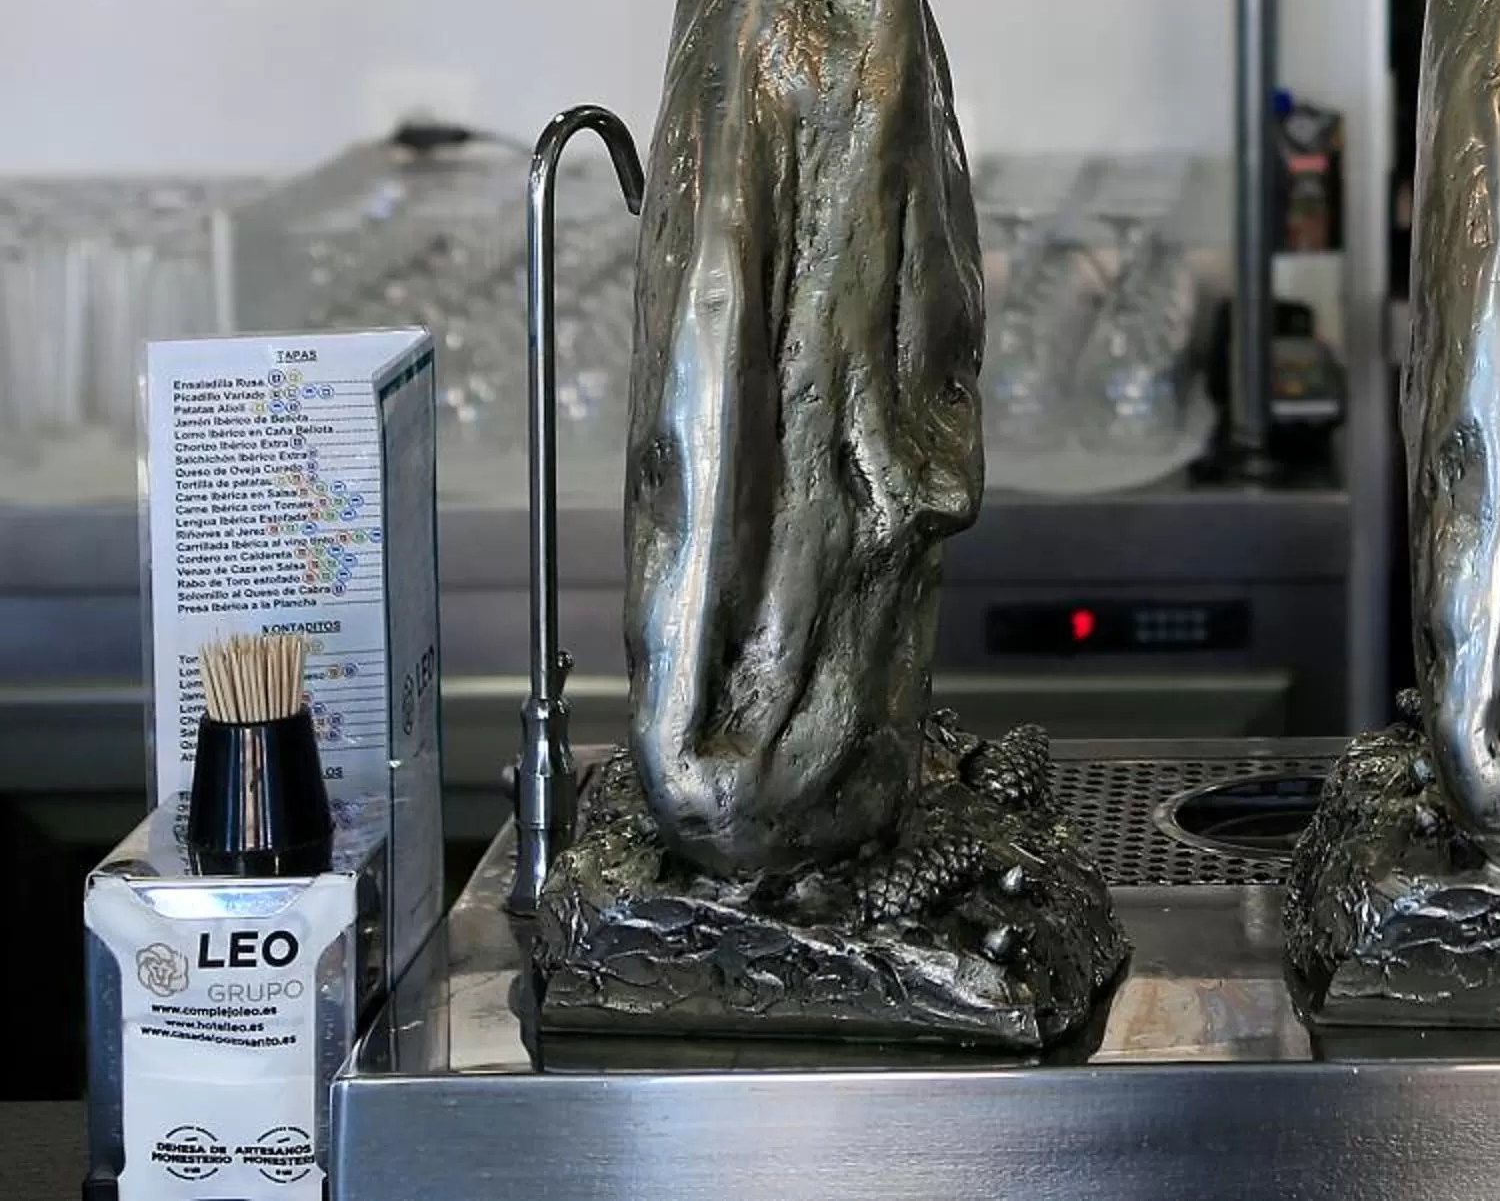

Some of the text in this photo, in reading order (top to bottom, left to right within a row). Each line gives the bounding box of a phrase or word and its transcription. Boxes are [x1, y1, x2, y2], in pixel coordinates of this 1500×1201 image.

[276, 350, 317, 362] TAPAS
[174, 379, 232, 389] Ensaladilla
[174, 391, 264, 401] Picadillo Variado
[174, 405, 214, 414] Patatas
[214, 415, 250, 426] Ibérico
[254, 415, 267, 423] de
[272, 414, 308, 423] Bellota
[175, 425, 333, 440] Lomo Ibérico en Caña Bellota
[175, 439, 288, 452] Chorizo Ibérico Extra
[240, 453, 276, 461] Ibérico
[280, 451, 306, 460] Extra
[176, 464, 302, 478] Queso de Oveja Curado
[176, 480, 212, 489] Tortilla
[216, 479, 229, 487] de
[176, 493, 208, 501] Carne
[211, 491, 248, 500] Ibérica
[267, 489, 296, 497] Salsa
[176, 501, 314, 515] Carne Ibérica con Tomate
[176, 513, 307, 529] Lengua Ibérica Estofada
[224, 529, 234, 537] al
[236, 528, 264, 537] Jerez
[232, 540, 268, 549] Ibérica
[272, 539, 280, 547] al
[284, 538, 306, 547] vino
[177, 550, 292, 564] Cordero en Caldereta
[214, 565, 227, 575] de
[230, 564, 256, 573] Caza
[260, 564, 273, 572] en
[276, 562, 305, 571] Salsa
[177, 575, 300, 589] Rabo de Toro estofado
[177, 585, 330, 601] Solomillo al Queso de Cabra
[177, 604, 208, 613] Presa
[212, 603, 248, 611] Ibérica
[260, 601, 270, 609] la
[274, 598, 316, 607] Plancha
[198, 930, 299, 968] LEO
[208, 980, 304, 1002] GRUPO
[156, 1142, 226, 1153] DEHESA DE
[243, 1155, 315, 1165] MONESTERI
